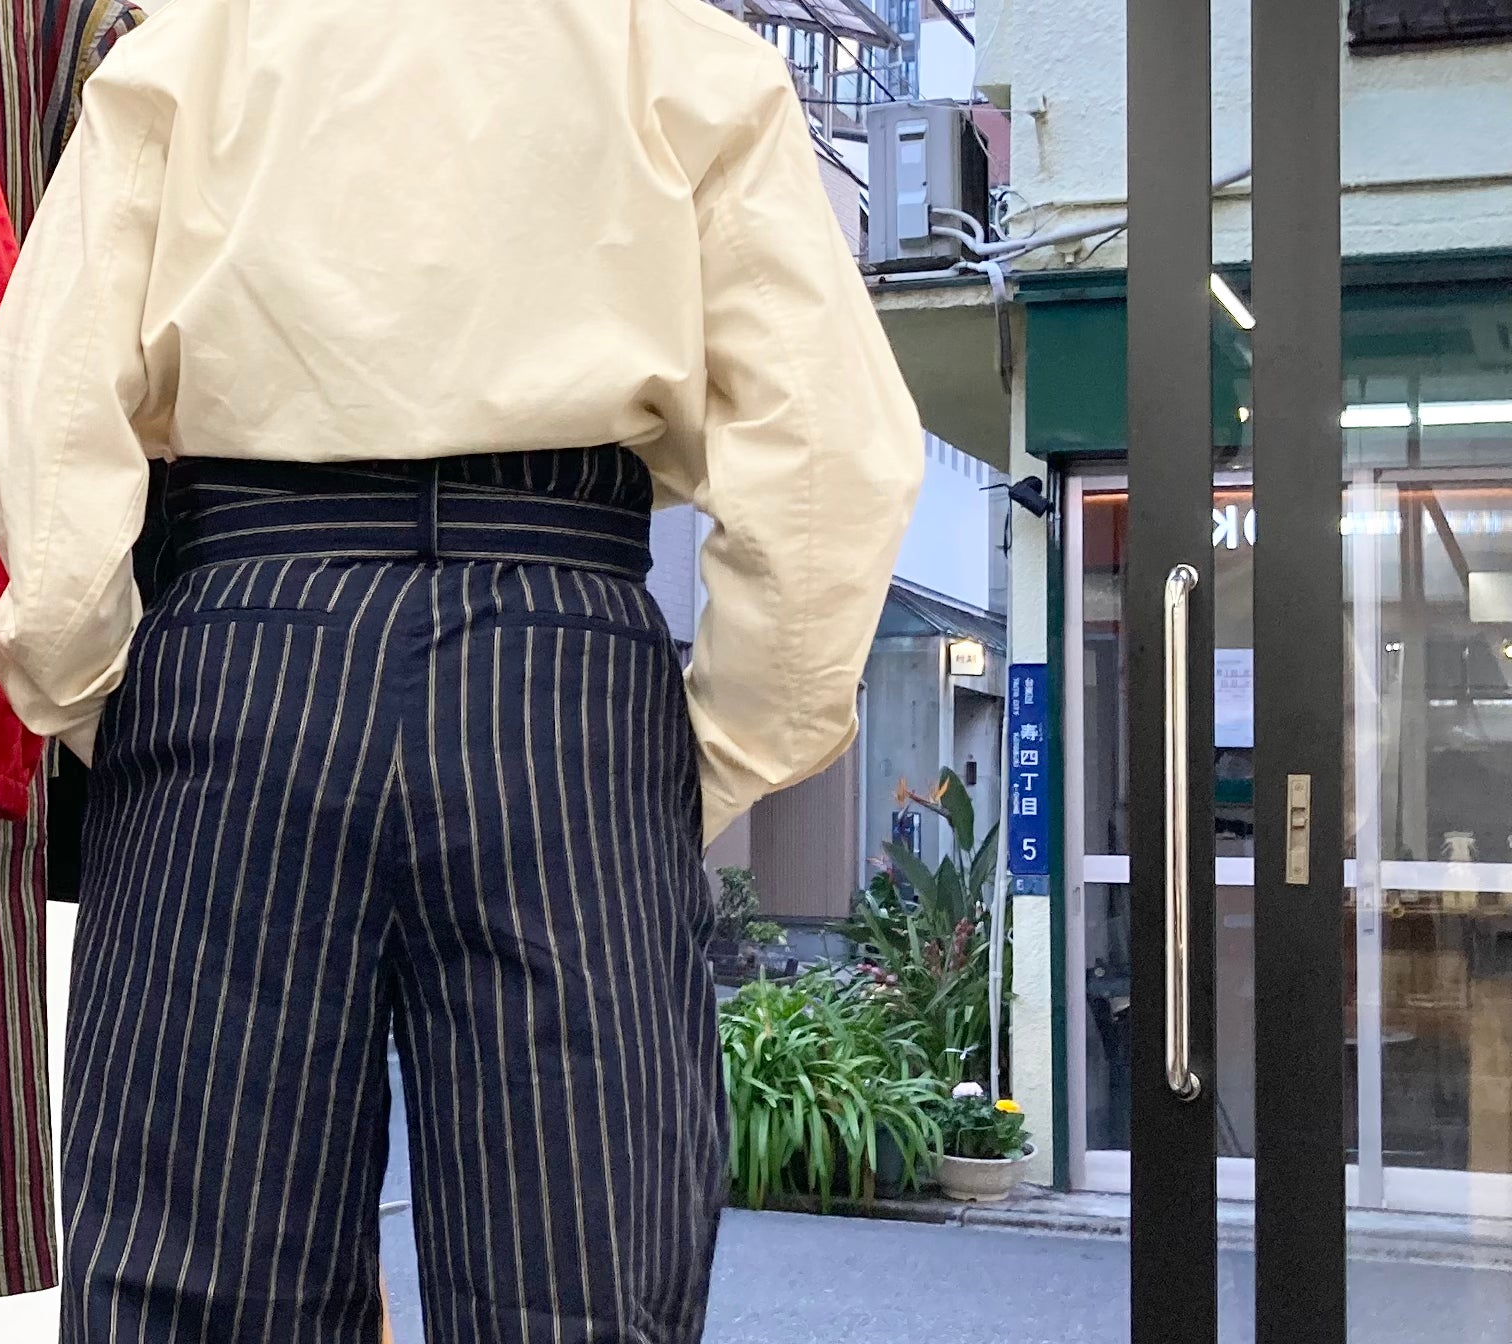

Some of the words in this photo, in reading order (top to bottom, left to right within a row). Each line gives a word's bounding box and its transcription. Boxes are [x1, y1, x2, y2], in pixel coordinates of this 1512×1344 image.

[1020, 723, 1039, 816] 寿四丁目
[1022, 838, 1037, 861] 5
